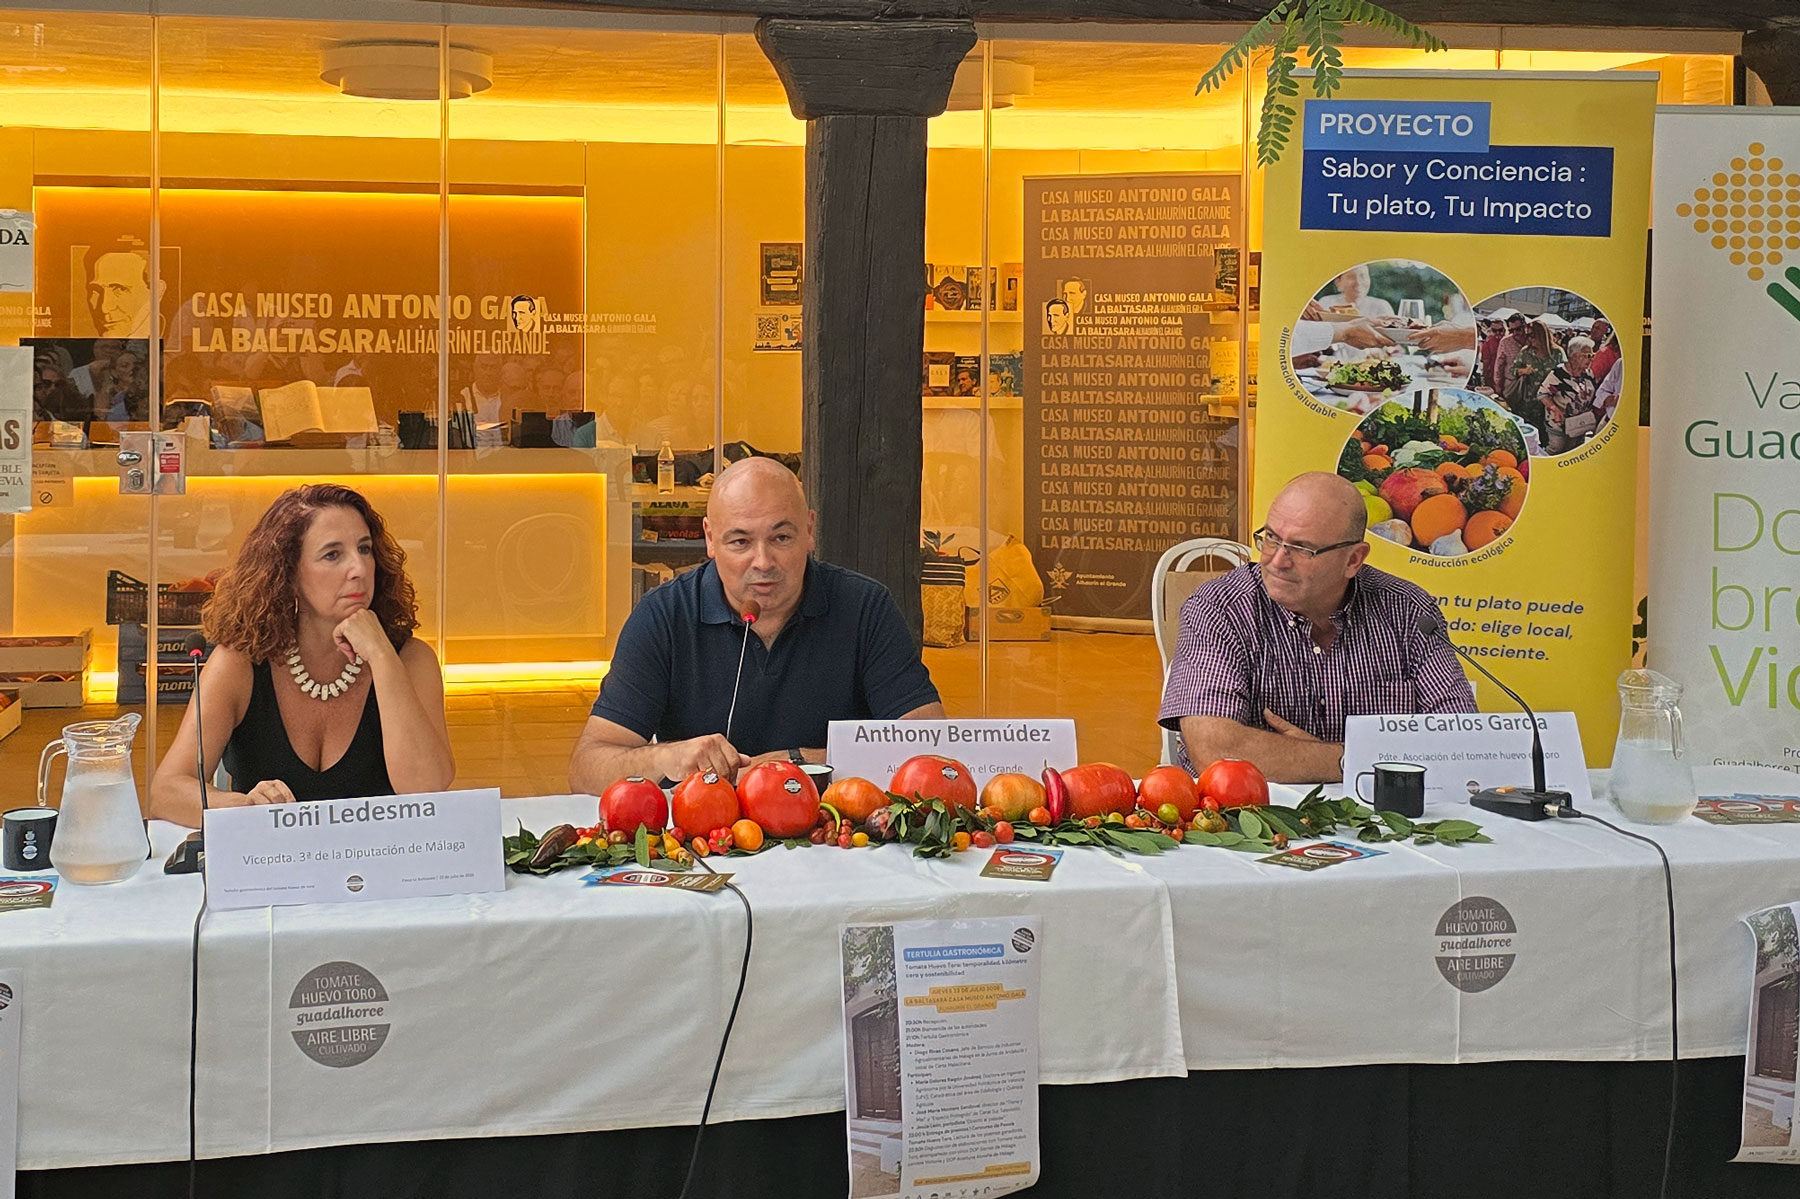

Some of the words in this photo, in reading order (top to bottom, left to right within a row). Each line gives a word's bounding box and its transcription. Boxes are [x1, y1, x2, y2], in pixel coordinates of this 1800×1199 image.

[1320, 112, 1474, 136] PROYECTO
[1321, 157, 1396, 180] Sabor
[1403, 163, 1419, 185] y
[1426, 159, 1573, 182] Conciencia
[1041, 190, 1069, 205] CASA
[1074, 189, 1113, 205] MUSEO
[1118, 188, 1187, 203] ANTONIO
[1191, 187, 1230, 202] GALA
[1041, 209, 1059, 223] LA
[1187, 206, 1197, 220] EL
[1197, 205, 1231, 220] GRANDE
[1328, 193, 1358, 214] Tu
[1366, 194, 1436, 220] plato,
[1444, 195, 1474, 217] Tu
[1483, 196, 1592, 223] Impacto
[1041, 227, 1069, 241] CASA
[1074, 226, 1113, 241] MUSEO
[1118, 225, 1187, 240] ANTONIO
[1191, 224, 1230, 239] GALA
[192, 292, 247, 318] CASA
[257, 292, 333, 319] MUSEO
[1094, 293, 1113, 303] CASA
[1143, 292, 1187, 302] ANTONIO
[1188, 292, 1214, 302] GALA
[590, 313, 632, 323] ANTONIO
[633, 314, 657, 323] GALA
[1076, 316, 1093, 325] CASA
[1120, 316, 1159, 325] ANTONIO
[1161, 316, 1183, 325] GALA
[192, 327, 228, 353] LA
[473, 329, 490, 354] EL
[491, 329, 551, 355] GRANDE
[1279, 326, 1297, 391] alimentación
[1294, 389, 1338, 420] saludable
[1041, 445, 1069, 459] CASA
[1074, 446, 1113, 460] MUSEO
[1117, 446, 1186, 461] ANTONIO
[1190, 447, 1230, 462] GALA
[1557, 443, 1602, 468] comercio
[1600, 422, 1619, 445] local
[1041, 463, 1059, 477] LA
[1187, 466, 1196, 480] EL
[1196, 466, 1231, 481] GRANDE
[1041, 481, 1069, 495] CASA
[1074, 482, 1113, 496] MUSEO
[1118, 483, 1187, 498] ANTONIO
[1191, 484, 1230, 499] GALA
[1041, 499, 1059, 513] LA
[1187, 503, 1196, 516] EL
[1196, 503, 1231, 518] GRANDE
[1041, 517, 1069, 531] CASA
[1074, 518, 1113, 532] MUSEO
[1118, 519, 1187, 534] ANTONIO
[1191, 520, 1230, 536] GALA
[1409, 555, 1469, 568] producción
[1471, 537, 1514, 564] ecológica
[1454, 595, 1472, 607] tu
[1476, 595, 1522, 611] plato
[1526, 601, 1584, 615] puede
[1481, 620, 1522, 638] elige
[1527, 622, 1573, 640] local,
[1379, 715, 1419, 732] José
[1424, 714, 1483, 732] Carlos
[1487, 714, 1548, 731] Garca
[854, 723, 942, 747] Anthony
[948, 722, 1051, 742] Bermúdez
[1403, 751, 1449, 762] Asociación
[1450, 751, 1465, 761] del
[1466, 751, 1498, 761] tomate
[1500, 751, 1527, 760] huevo
[979, 764, 987, 774] el
[988, 764, 1024, 774] Grande
[269, 804, 320, 829] Toñi
[328, 799, 436, 825] Ledesma
[243, 853, 296, 866] Vicepdta.
[314, 850, 329, 861] de
[332, 849, 342, 860] la
[345, 843, 406, 860] Diputación
[408, 842, 422, 854] de
[425, 839, 466, 854] Málaga
[1445, 922, 1478, 934] HUEVO
[1481, 920, 1507, 932] TORO
[906, 950, 941, 959] TERTULIA
[942, 947, 1002, 957] GASTRONÓMICA
[1440, 937, 1512, 953] guadalhorce
[1447, 958, 1471, 971] AIRE
[1474, 957, 1504, 970] LIBRE
[315, 974, 360, 990] TOMATE
[301, 990, 341, 1005] HUEVO
[344, 987, 376, 1001] TORO
[296, 1006, 384, 1026] guadalhorce
[306, 1030, 337, 1046] AIRE
[341, 1027, 377, 1042] LIBRE
[318, 1043, 367, 1056] CULTIVADO
